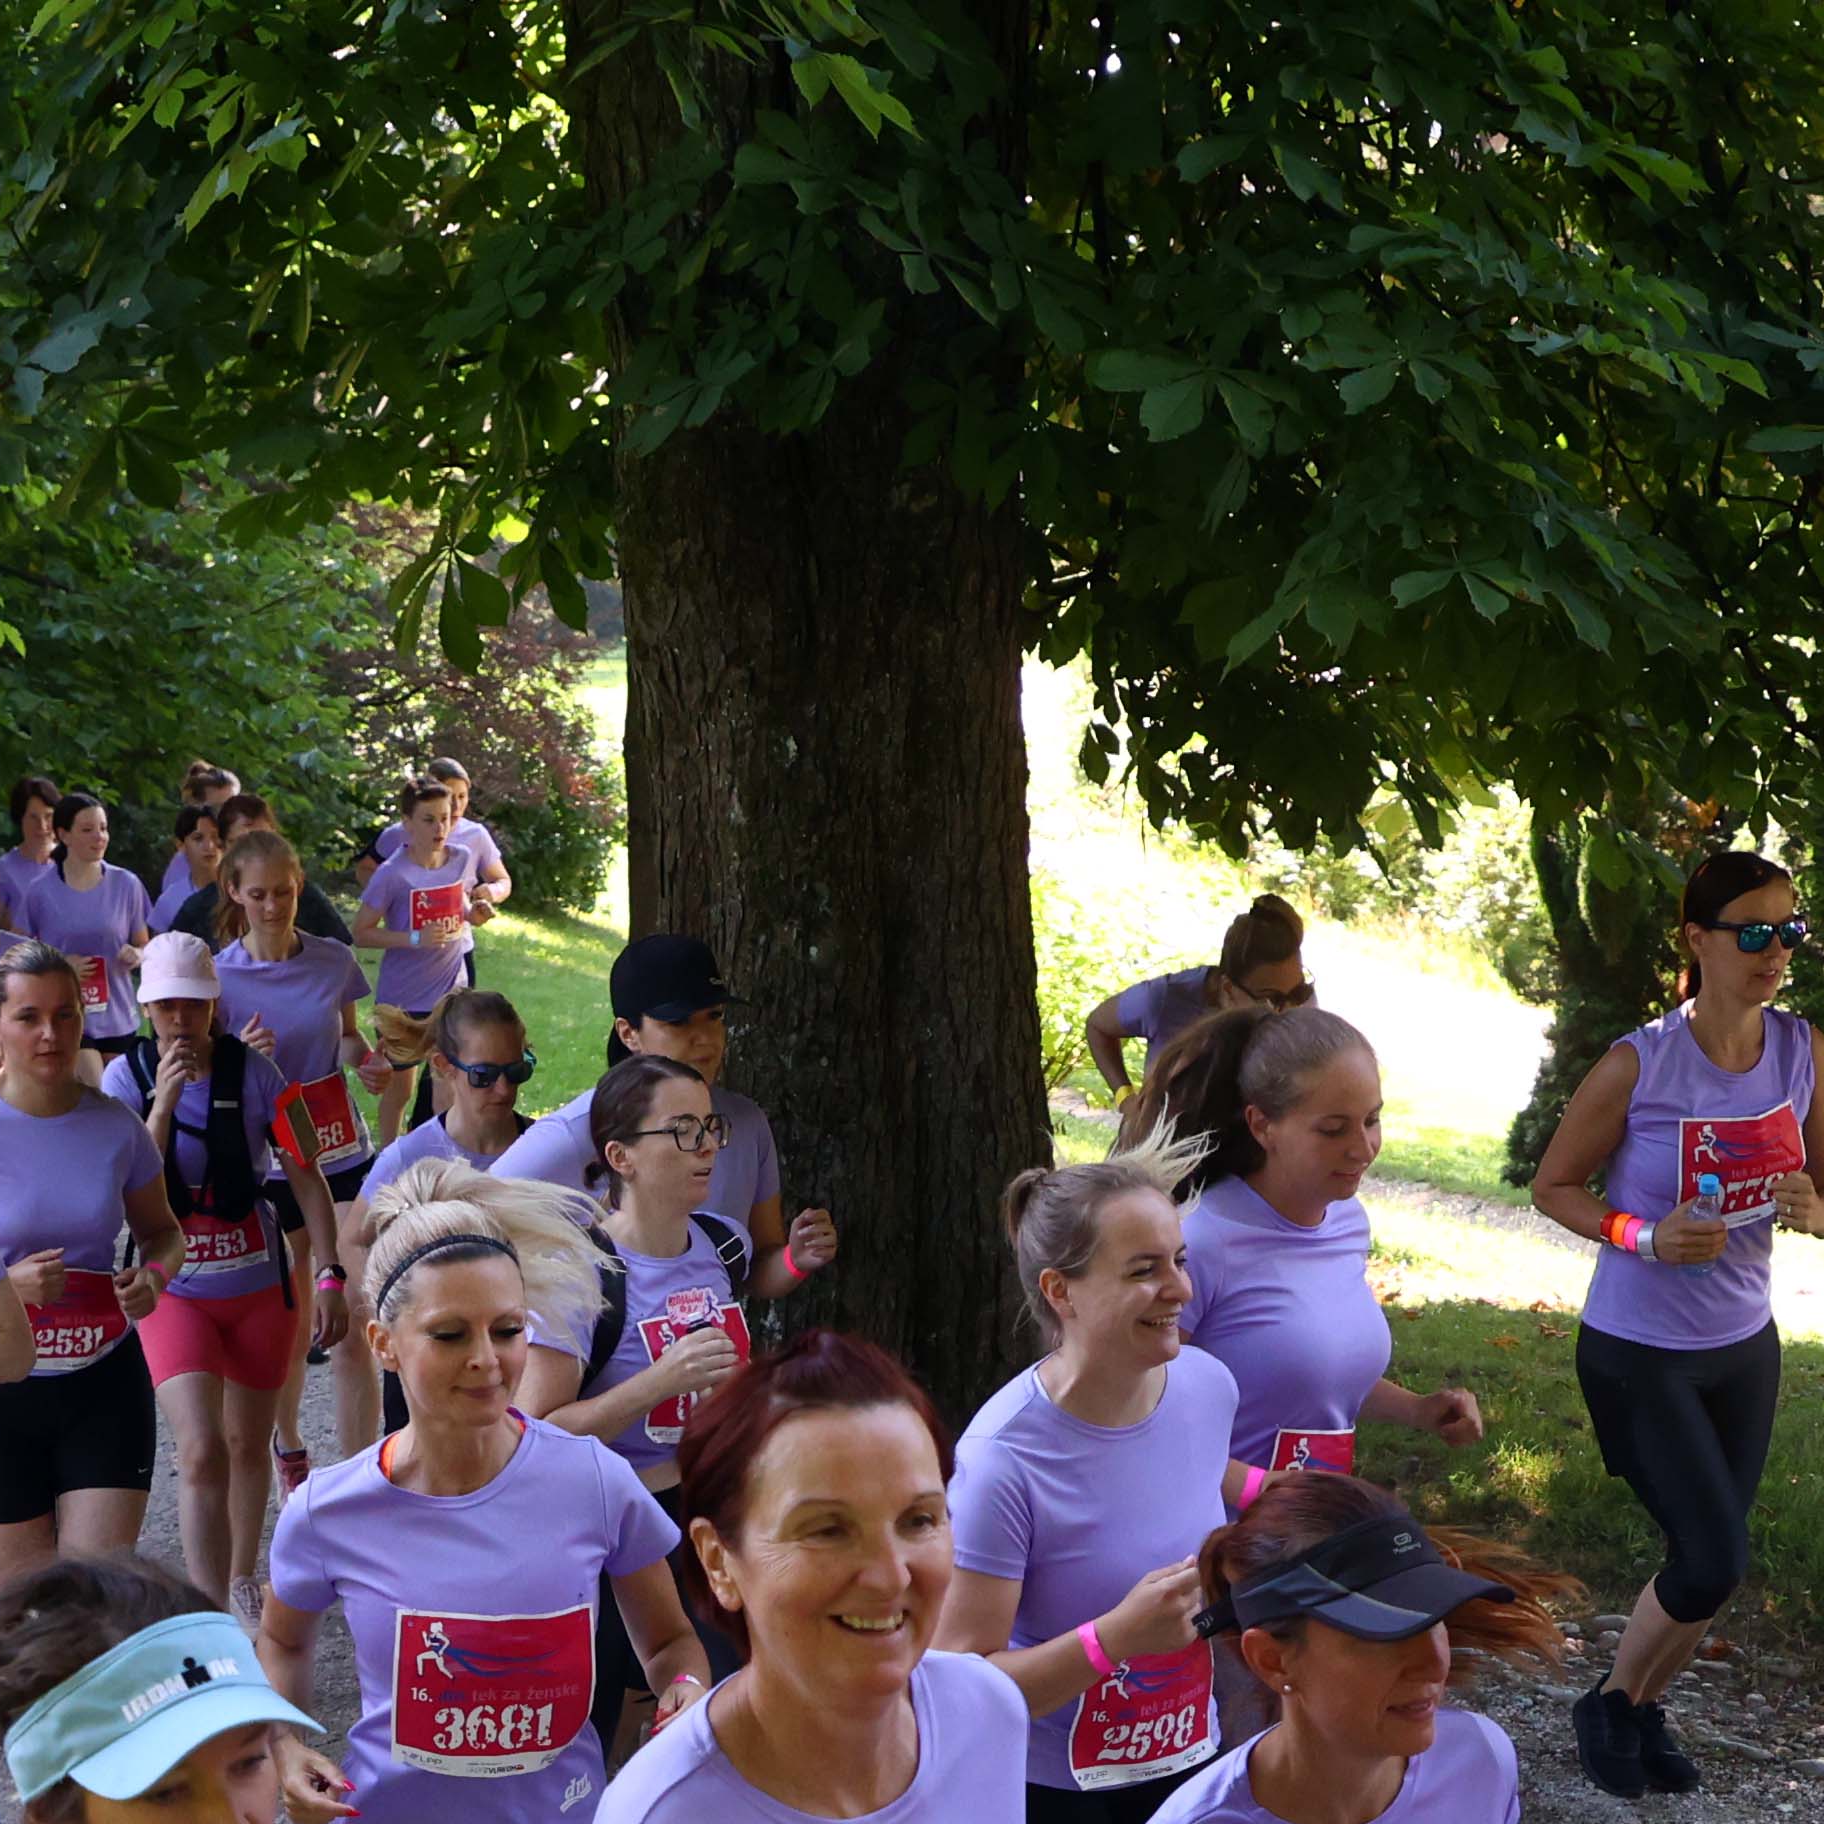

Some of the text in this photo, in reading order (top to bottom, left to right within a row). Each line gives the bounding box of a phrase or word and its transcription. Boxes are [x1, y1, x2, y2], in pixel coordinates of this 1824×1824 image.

[36, 1326, 104, 1355] 2531
[410, 1687, 433, 1702] 16.
[433, 1703, 554, 1750] 3681
[1091, 1710, 1110, 1723] 16.
[1097, 1704, 1196, 1760] 2598
